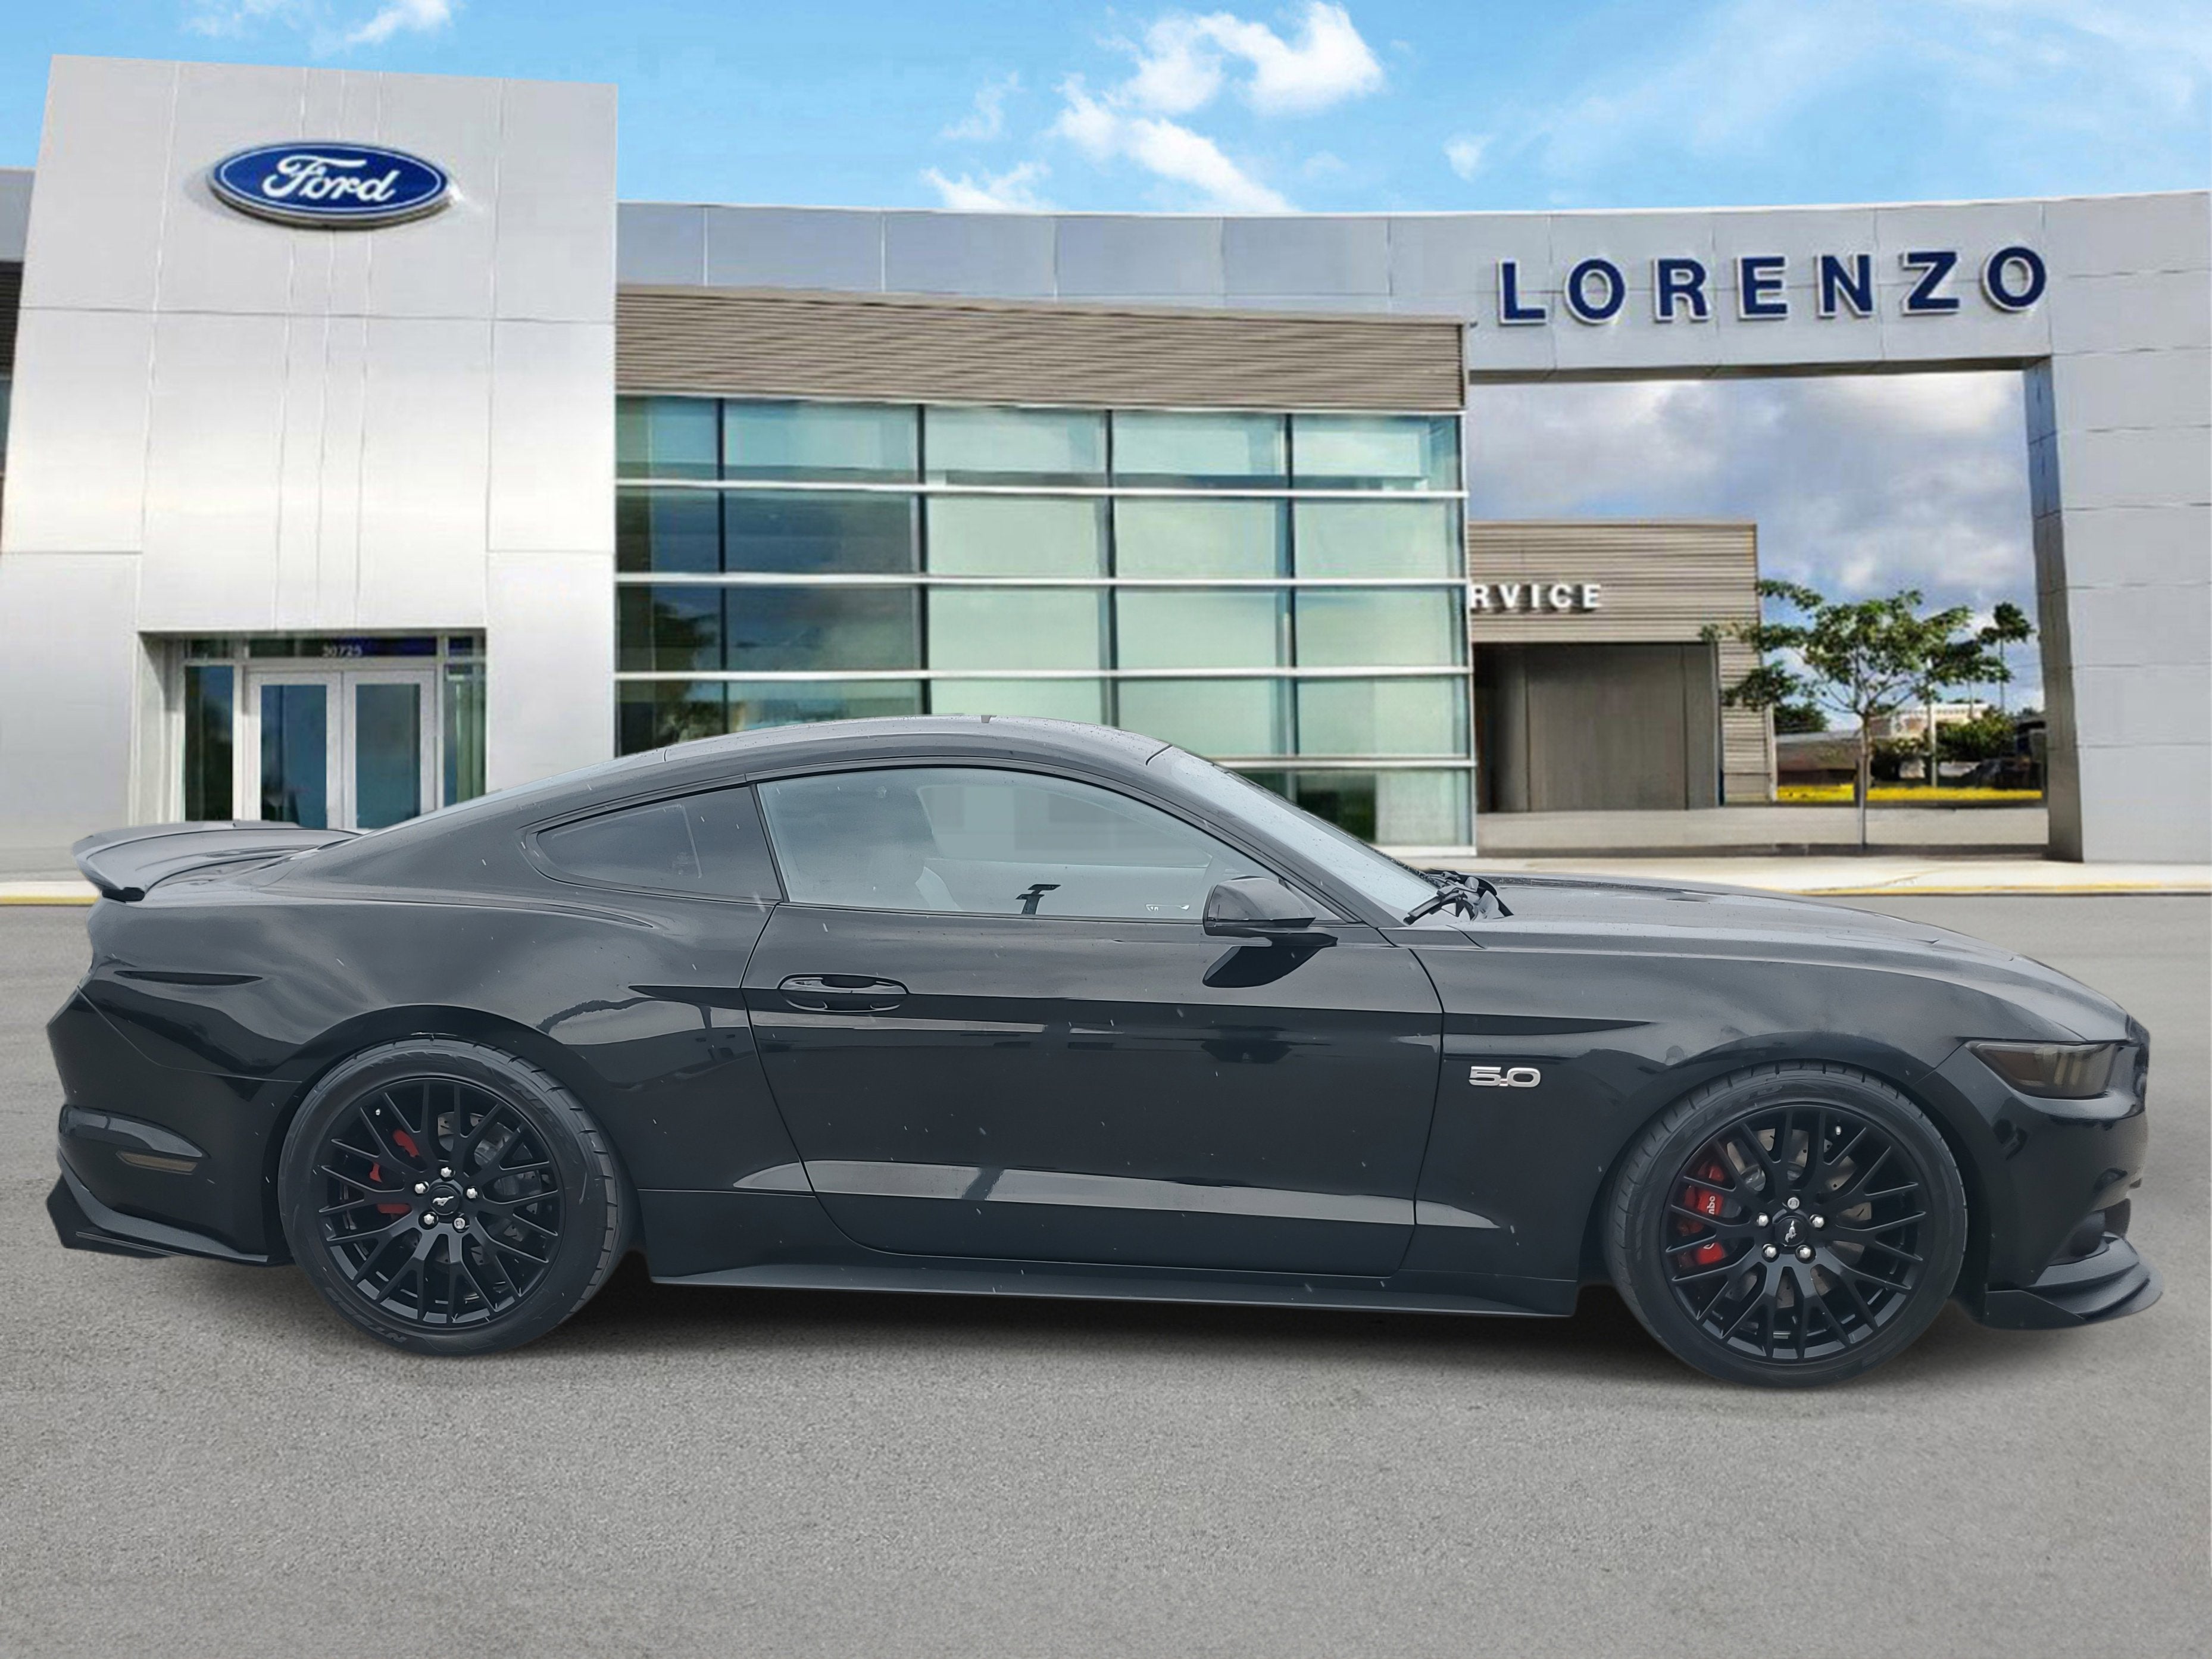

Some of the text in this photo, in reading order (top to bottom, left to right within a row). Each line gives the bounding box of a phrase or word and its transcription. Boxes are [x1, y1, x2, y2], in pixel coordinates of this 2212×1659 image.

[262, 155, 400, 201] Ford
[1497, 246, 2047, 325] LORENZO
[1470, 583, 1602, 609] RVICE
[1469, 1066, 1541, 1088] 5.0
